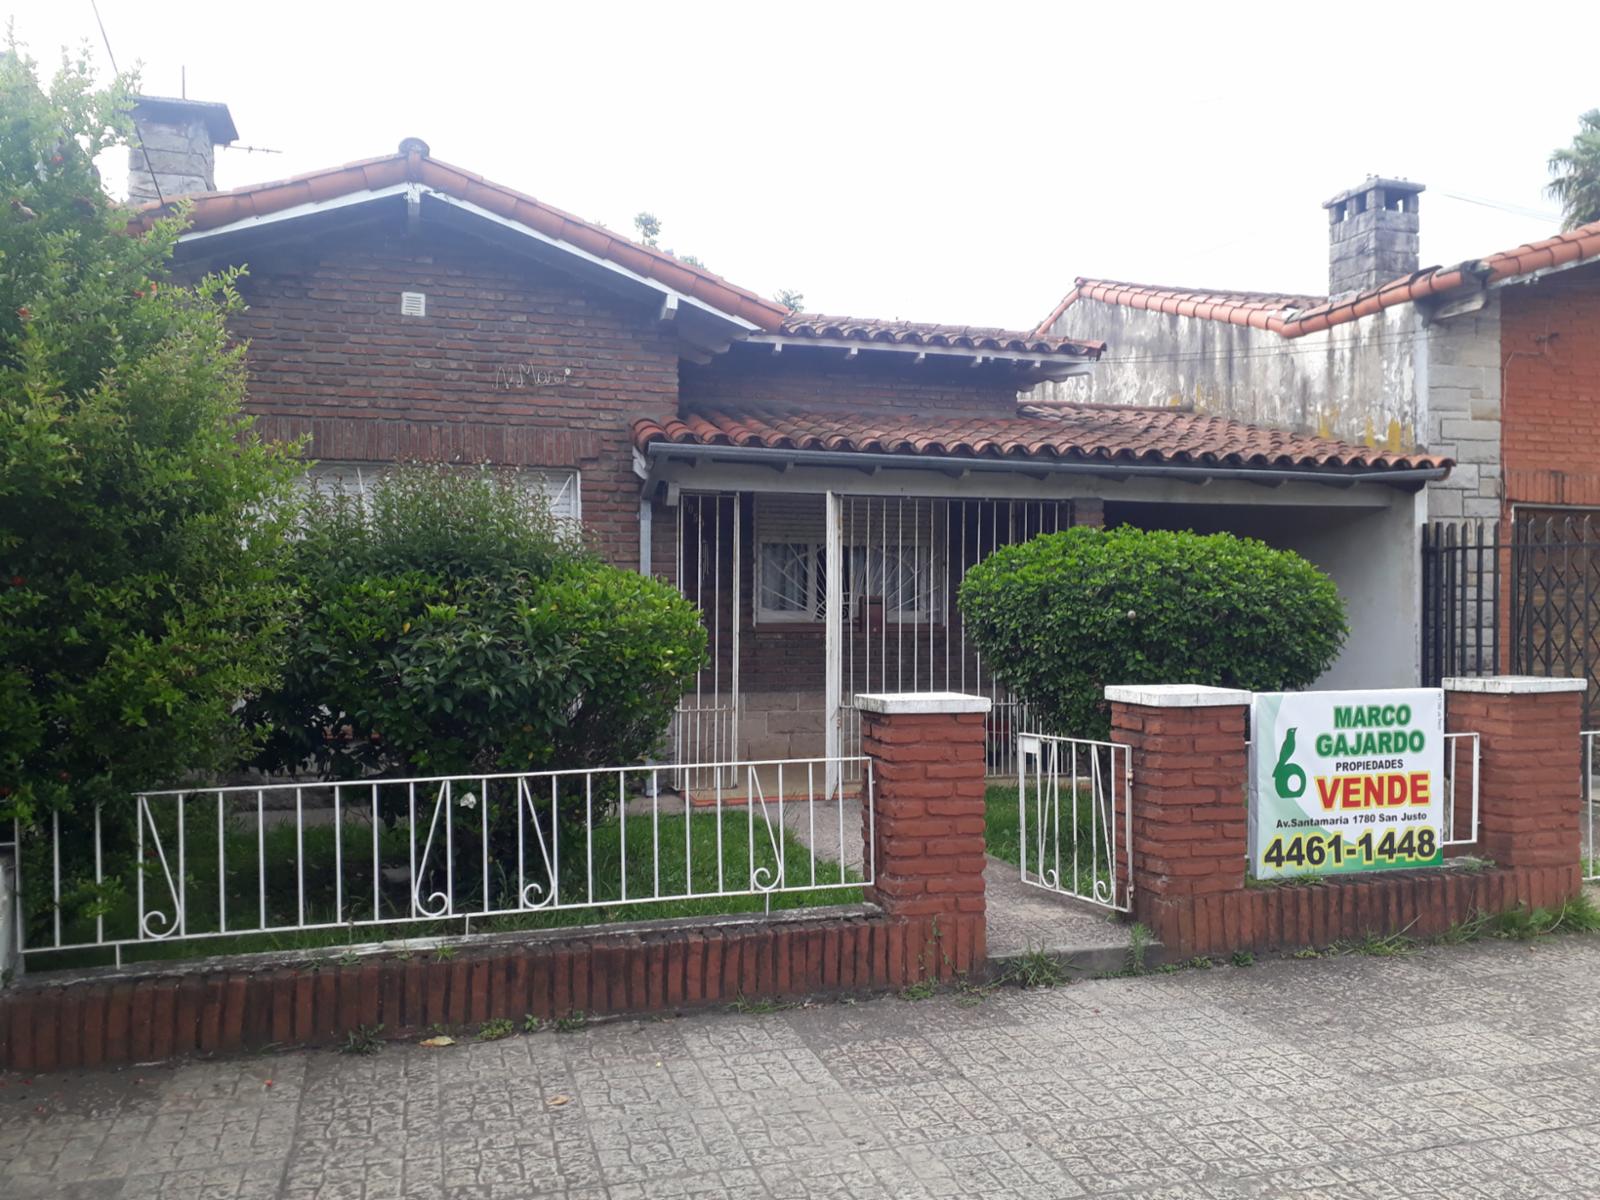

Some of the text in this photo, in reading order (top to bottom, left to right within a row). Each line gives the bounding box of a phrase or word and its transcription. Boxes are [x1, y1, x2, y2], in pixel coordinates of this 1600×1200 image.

[1333, 704, 1411, 728] MARCO
[1315, 731, 1425, 757] GAJARDO
[1335, 759, 1403, 772] PROPIEDADES
[1316, 773, 1430, 809] VENDE
[1352, 813, 1376, 825] 1780
[1378, 813, 1398, 823] San
[1400, 811, 1427, 821] Justo
[1263, 828, 1436, 868] 4461-1448
